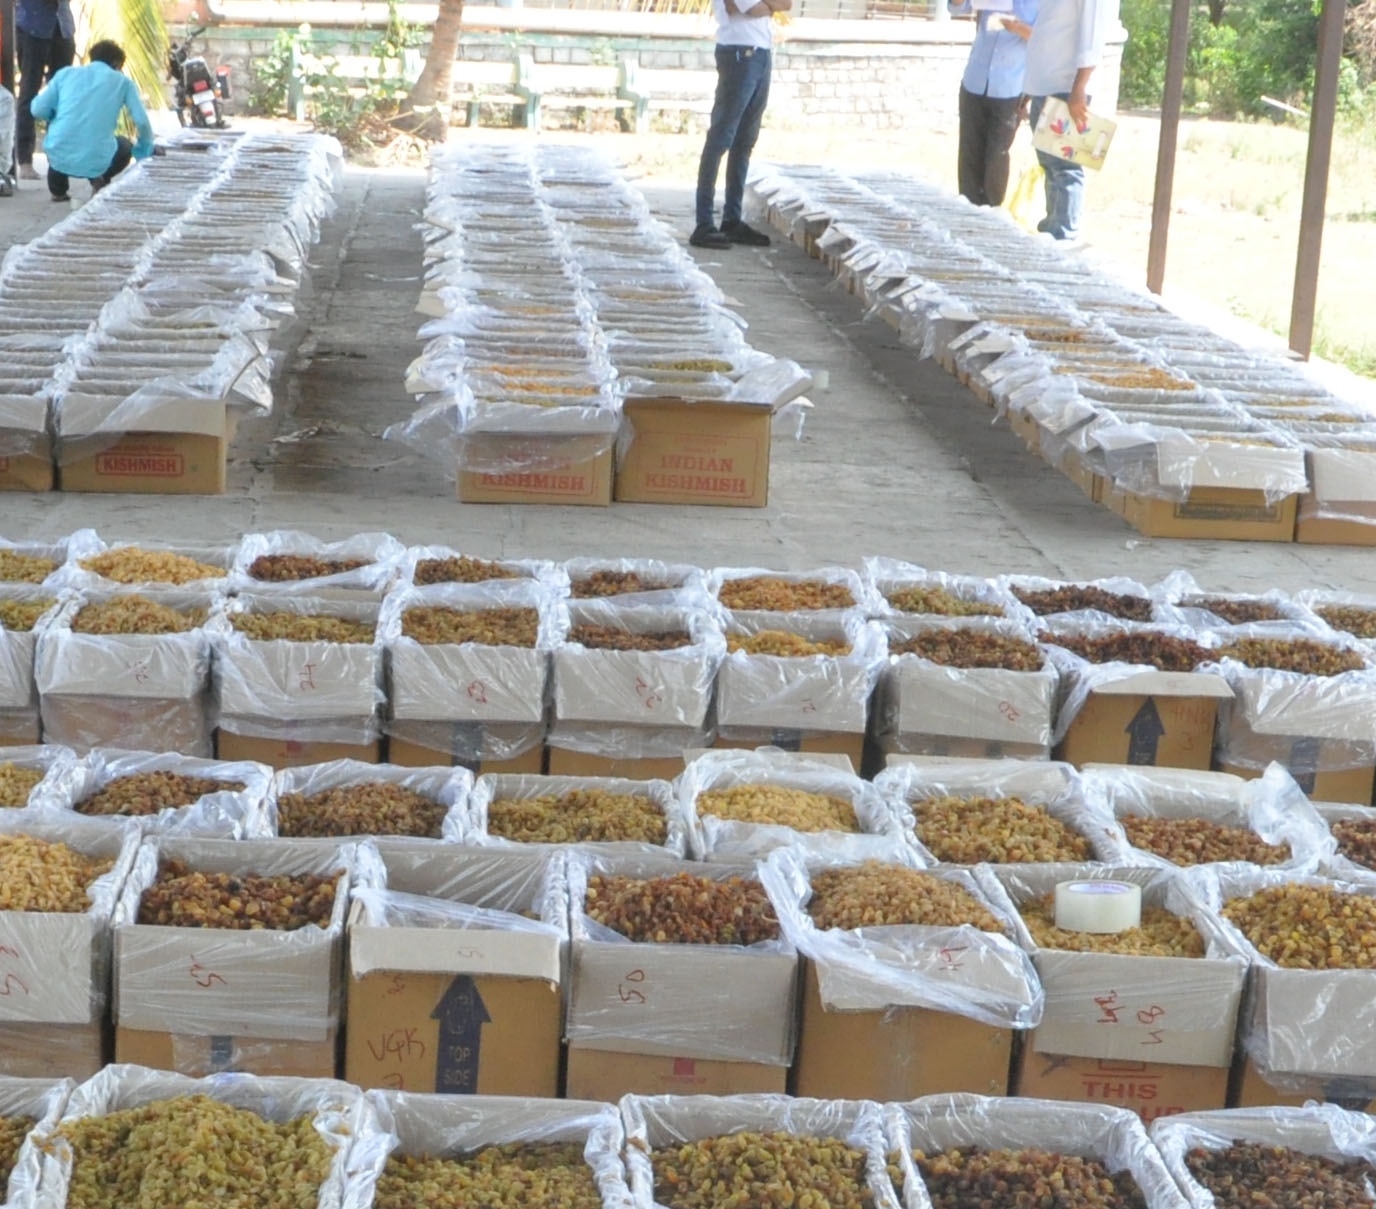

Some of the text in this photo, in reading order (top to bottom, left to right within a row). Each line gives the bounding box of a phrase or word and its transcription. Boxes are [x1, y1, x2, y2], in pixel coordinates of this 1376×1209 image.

[103, 457, 177, 473] KISHMISH
[660, 455, 734, 473] INDIAN
[481, 473, 585, 491] KISHMISH
[645, 472, 747, 493] KISHMISH
[618, 968, 647, 1004] 50
[449, 1045, 471, 1062] TOP
[443, 1068, 471, 1086] SIDE
[1082, 1080, 1159, 1100] THIS
